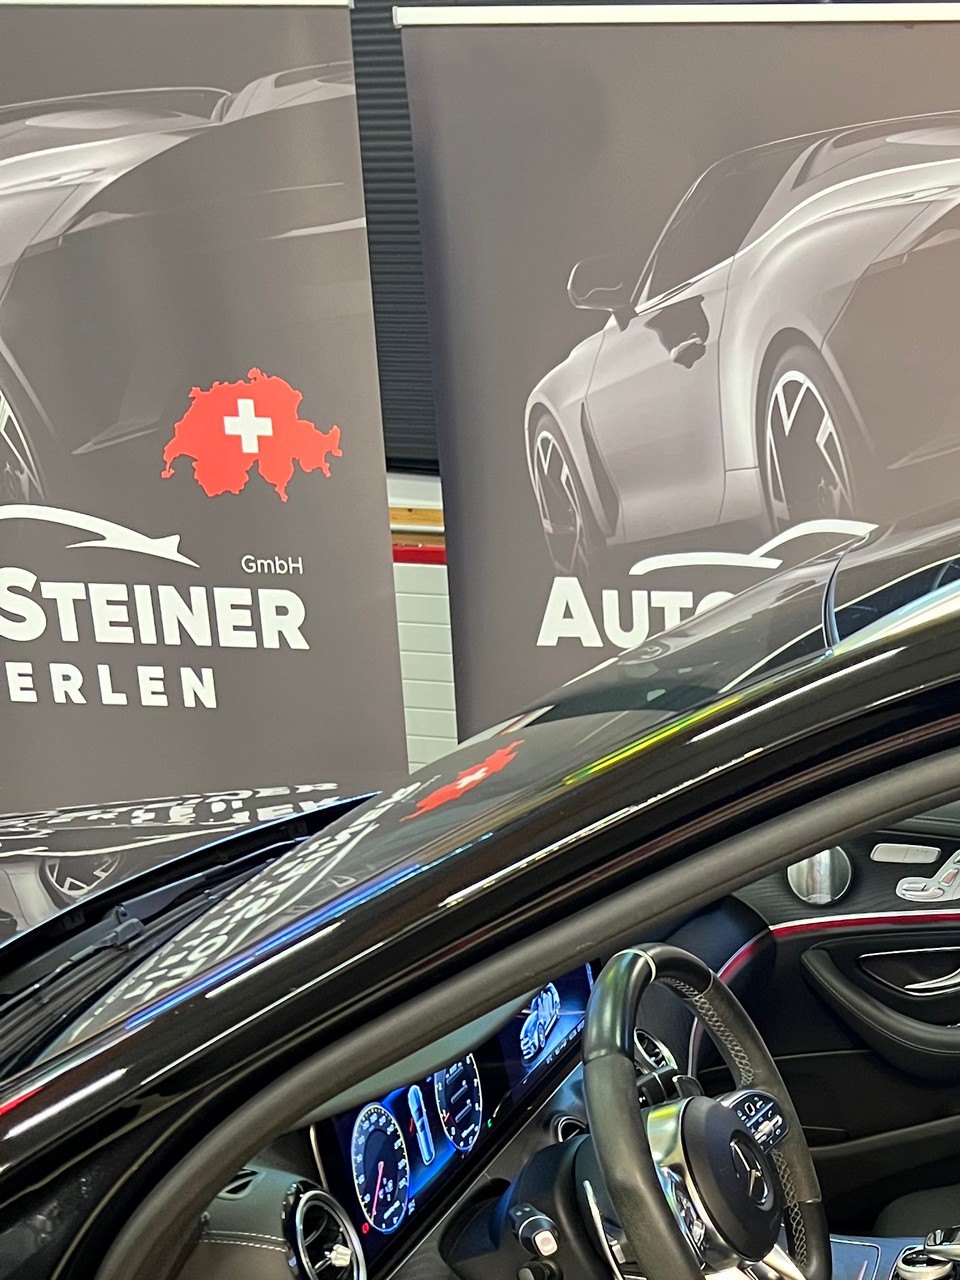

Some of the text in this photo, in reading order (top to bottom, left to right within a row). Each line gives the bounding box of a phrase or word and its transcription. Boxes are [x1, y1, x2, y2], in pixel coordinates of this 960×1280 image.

[240, 554, 304, 576] GmbH
[0, 566, 311, 650] STEINER
[4, 661, 218, 709] ERLEN
